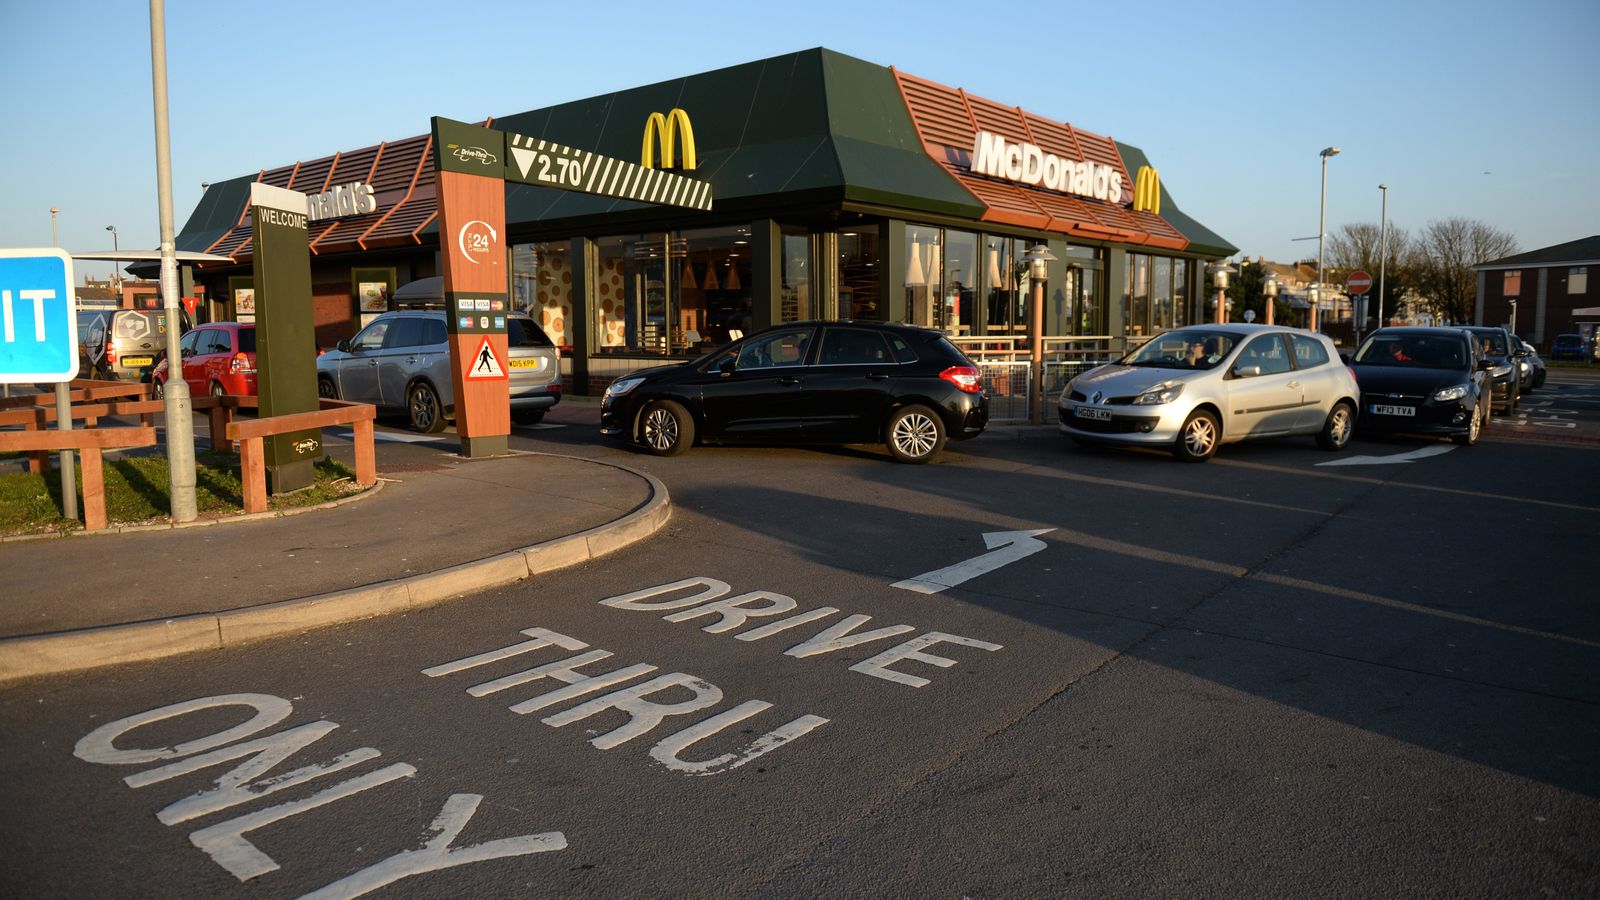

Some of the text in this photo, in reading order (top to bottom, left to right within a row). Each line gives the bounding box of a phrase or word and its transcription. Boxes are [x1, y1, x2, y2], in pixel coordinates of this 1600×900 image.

[538, 155, 582, 186] 2.70
[971, 131, 1122, 203] McDonald's
[260, 208, 308, 230] WELCOME
[473, 234, 489, 247] 24
[599, 576, 1003, 688] DRIVE
[421, 626, 832, 775] THRU
[73, 692, 569, 900] ONLY
